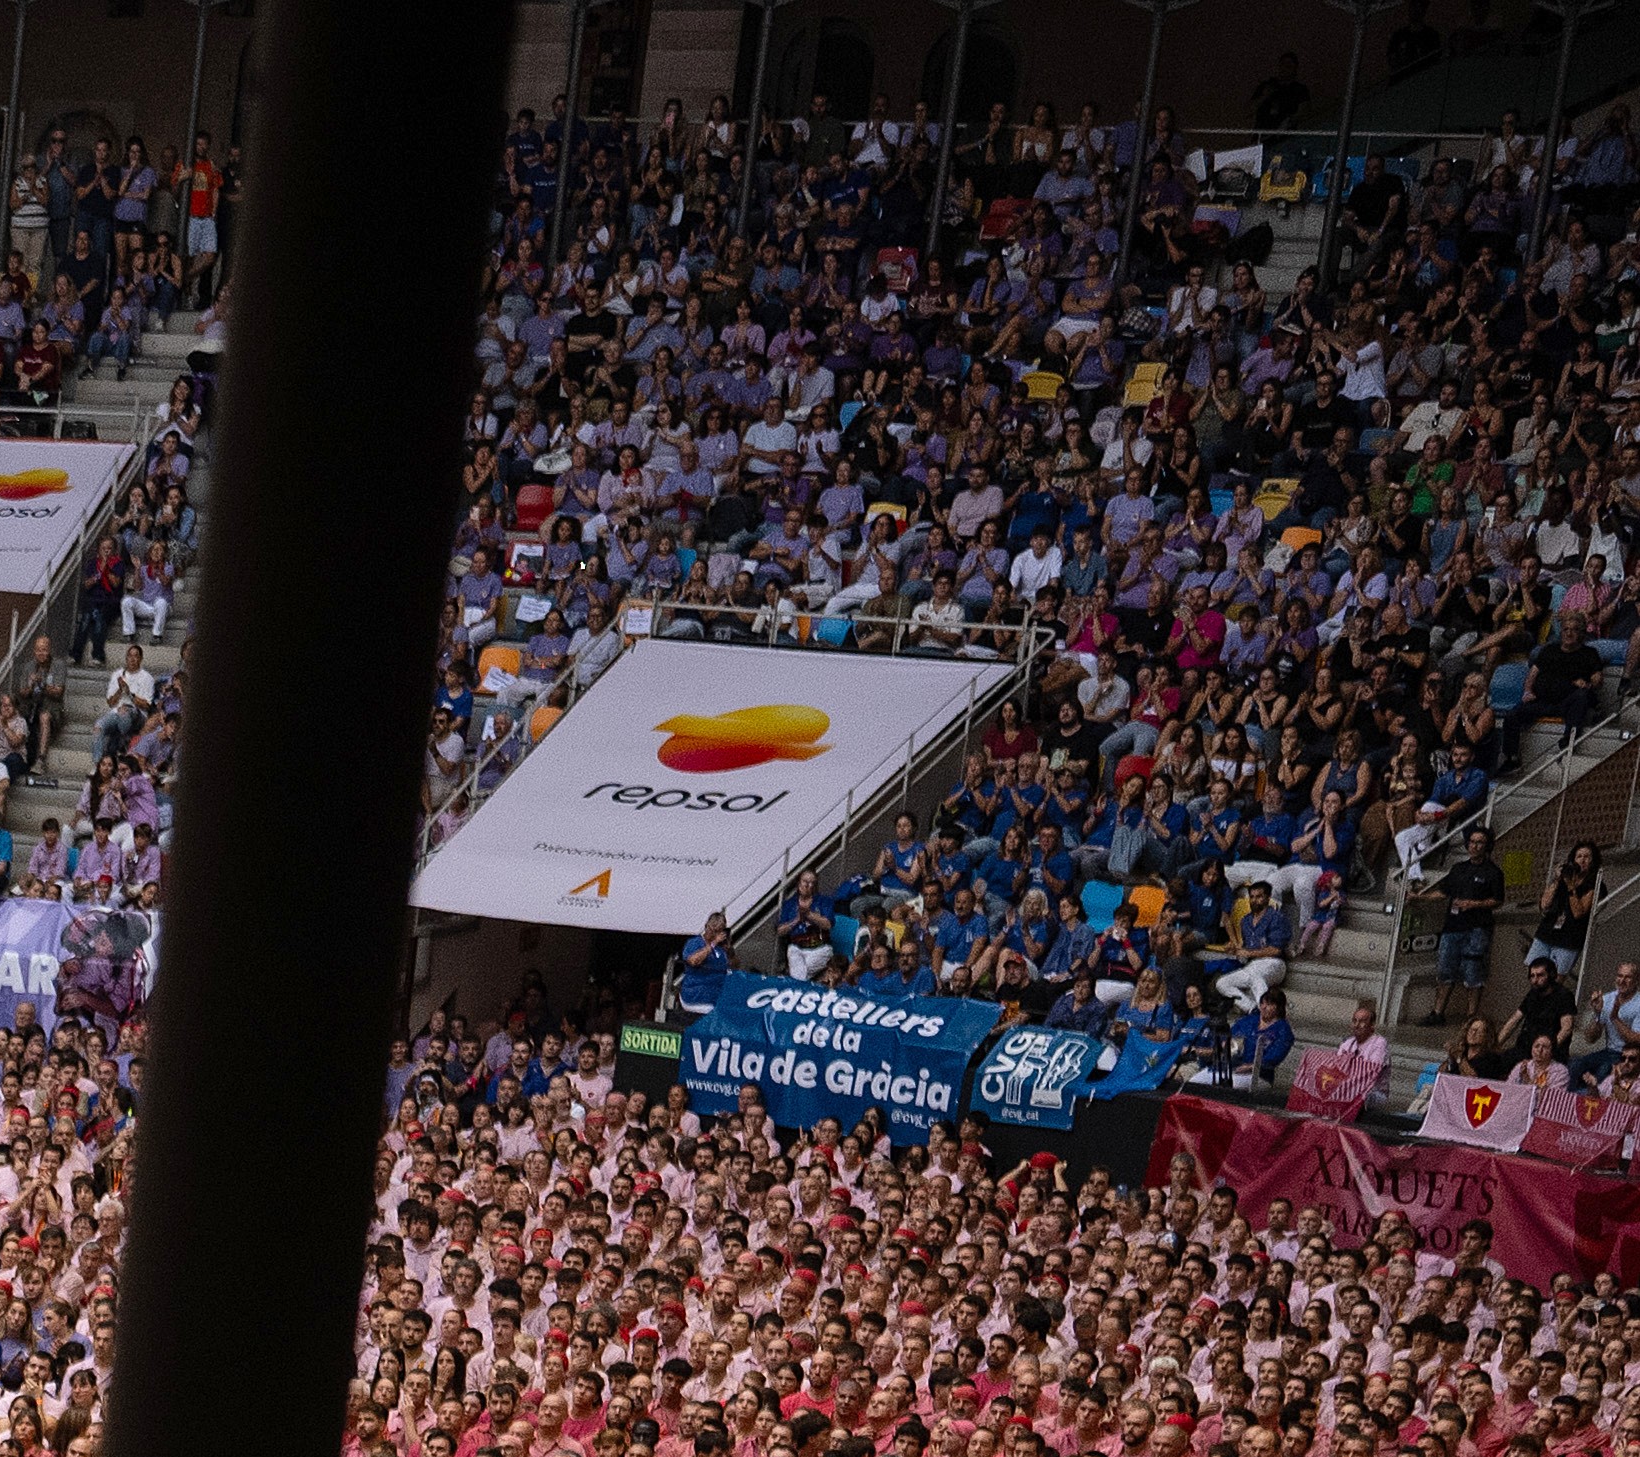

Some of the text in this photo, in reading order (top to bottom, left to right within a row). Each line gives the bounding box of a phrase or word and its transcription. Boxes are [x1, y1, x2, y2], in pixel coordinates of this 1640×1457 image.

[583, 783, 790, 813] repsol
[747, 985, 945, 1038] castellers
[623, 1028, 678, 1055] SORTIDA
[793, 1020, 862, 1053] de la
[691, 1038, 952, 1113] Vila de Gràcia
[981, 1031, 1037, 1104] CVG
